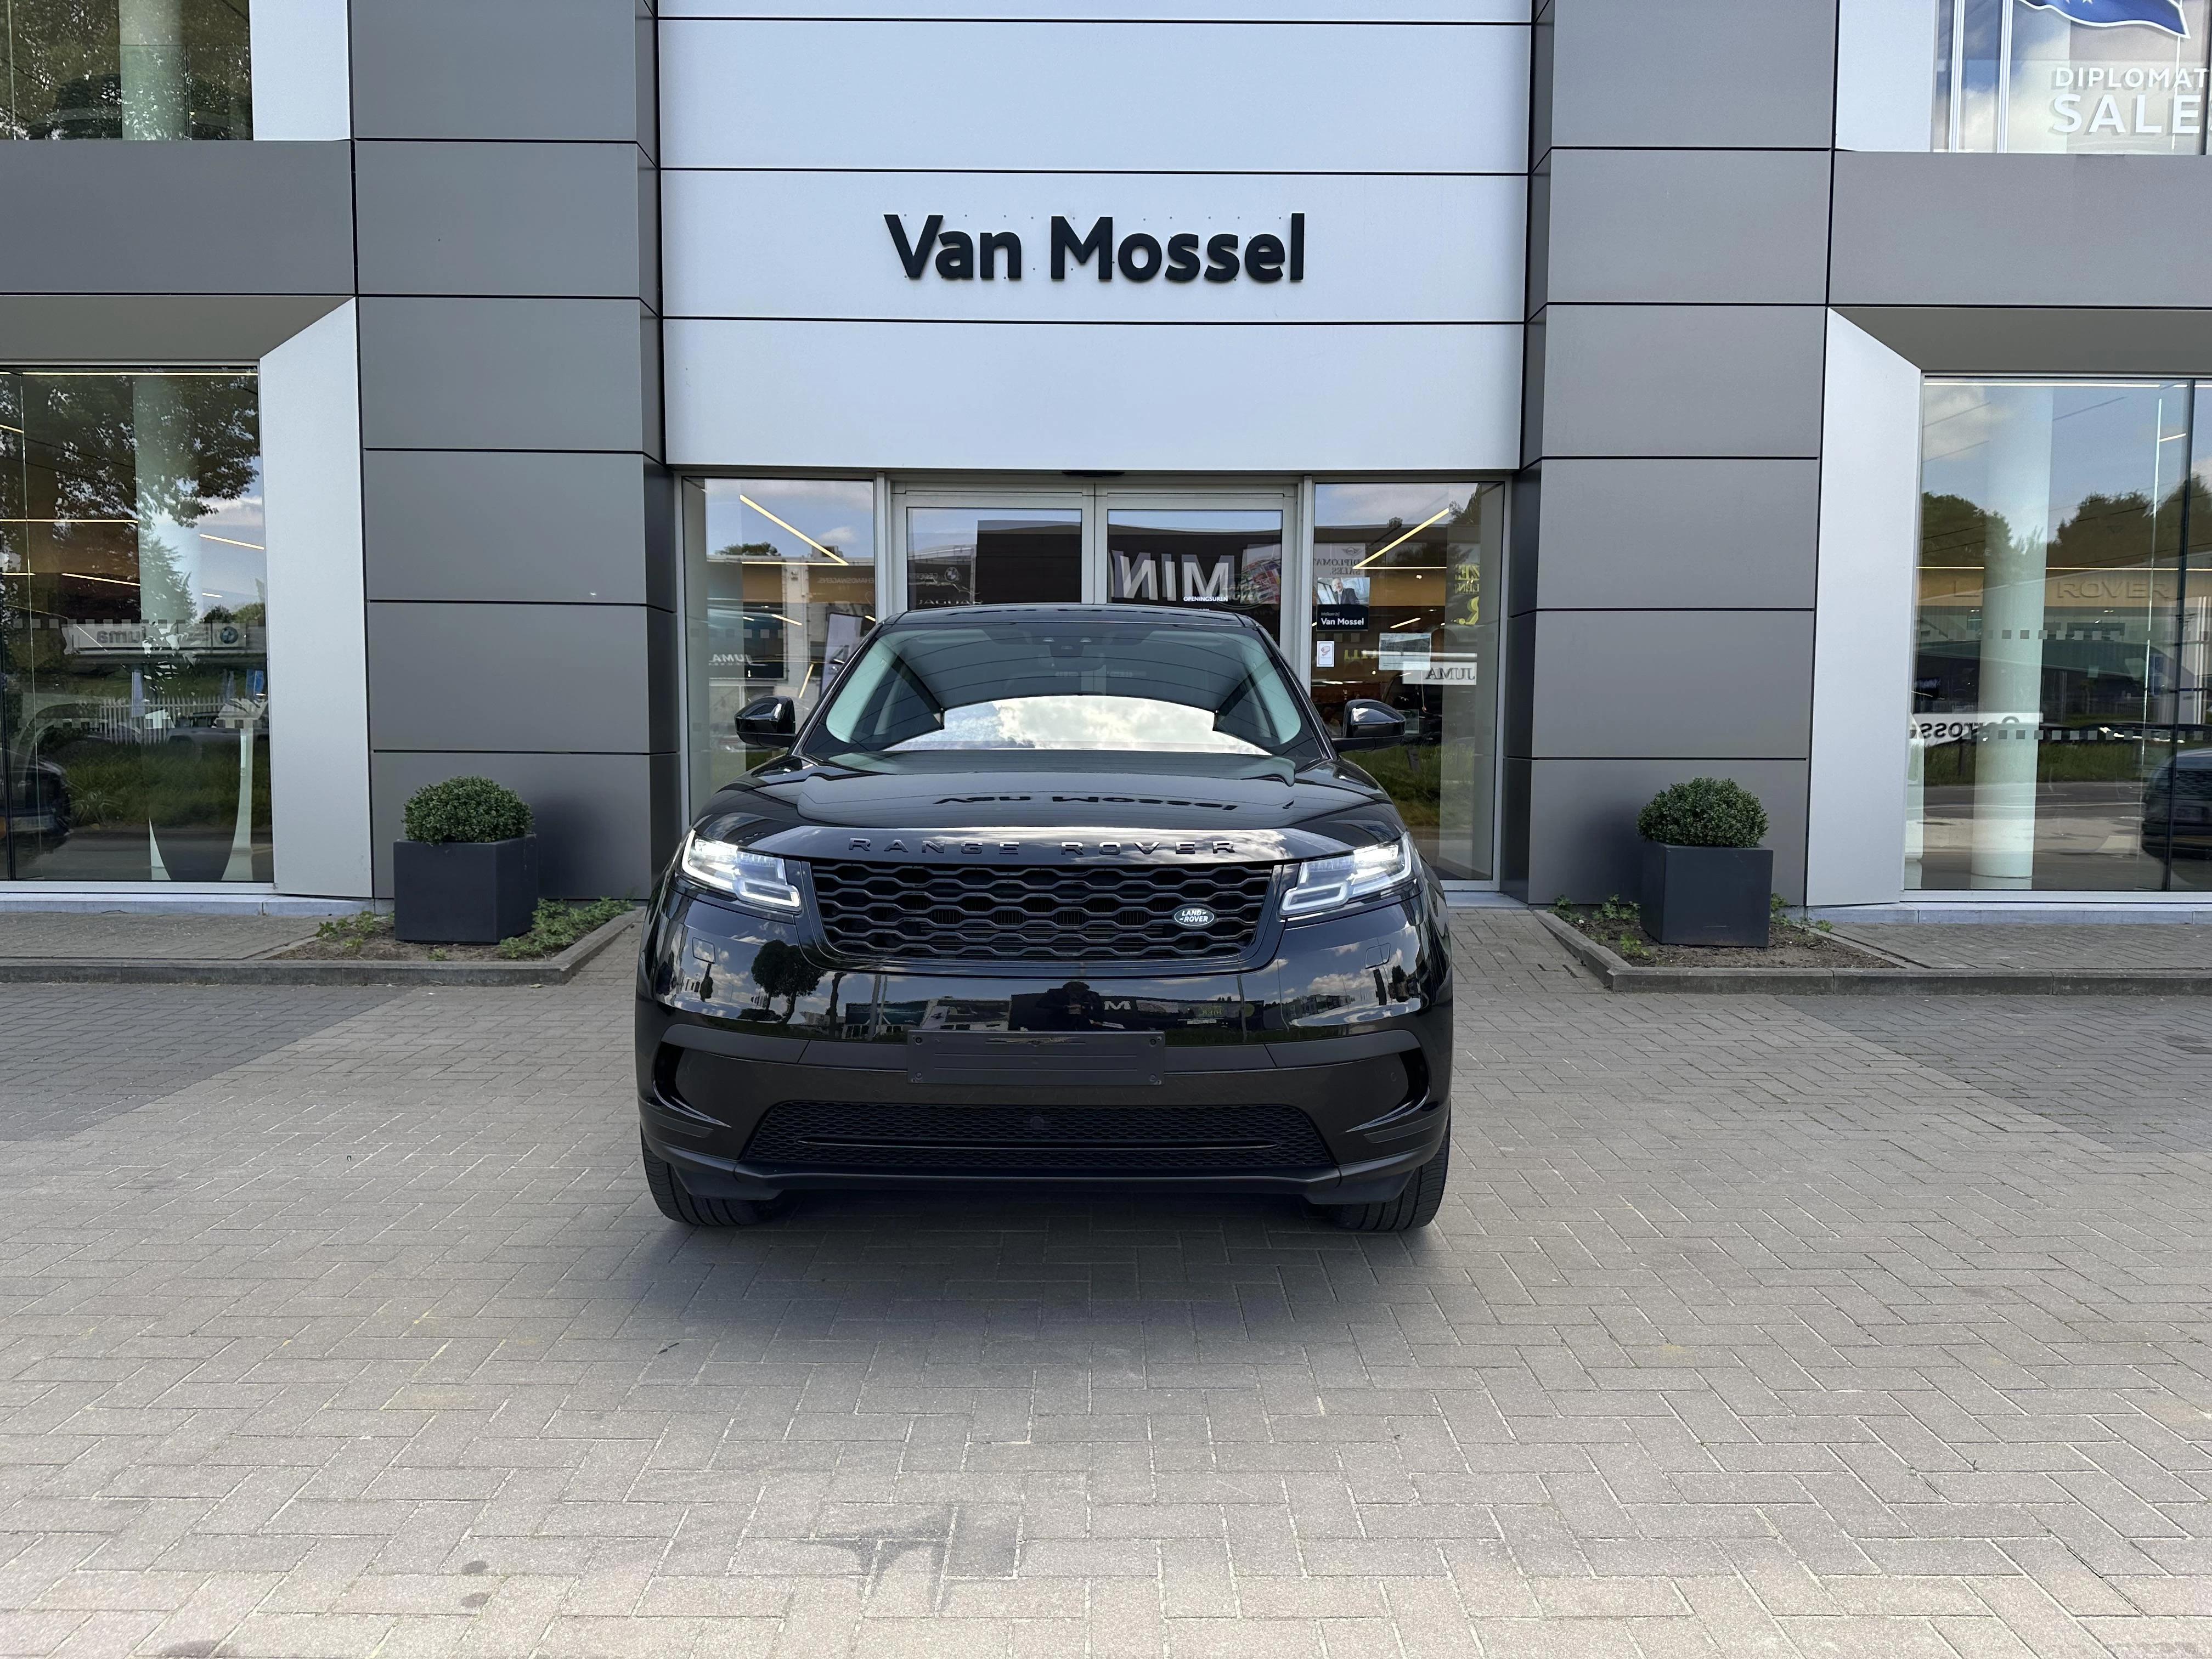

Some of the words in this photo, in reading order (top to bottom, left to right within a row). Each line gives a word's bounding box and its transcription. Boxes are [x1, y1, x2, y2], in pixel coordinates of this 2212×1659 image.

[2053, 93, 2212, 133] SALE
[883, 214, 1022, 279] Van
[1051, 212, 1305, 281] Mossel
[1337, 617, 1364, 625] Mossel
[849, 837, 1019, 855] RANGE
[1060, 840, 1235, 855] ROVER
